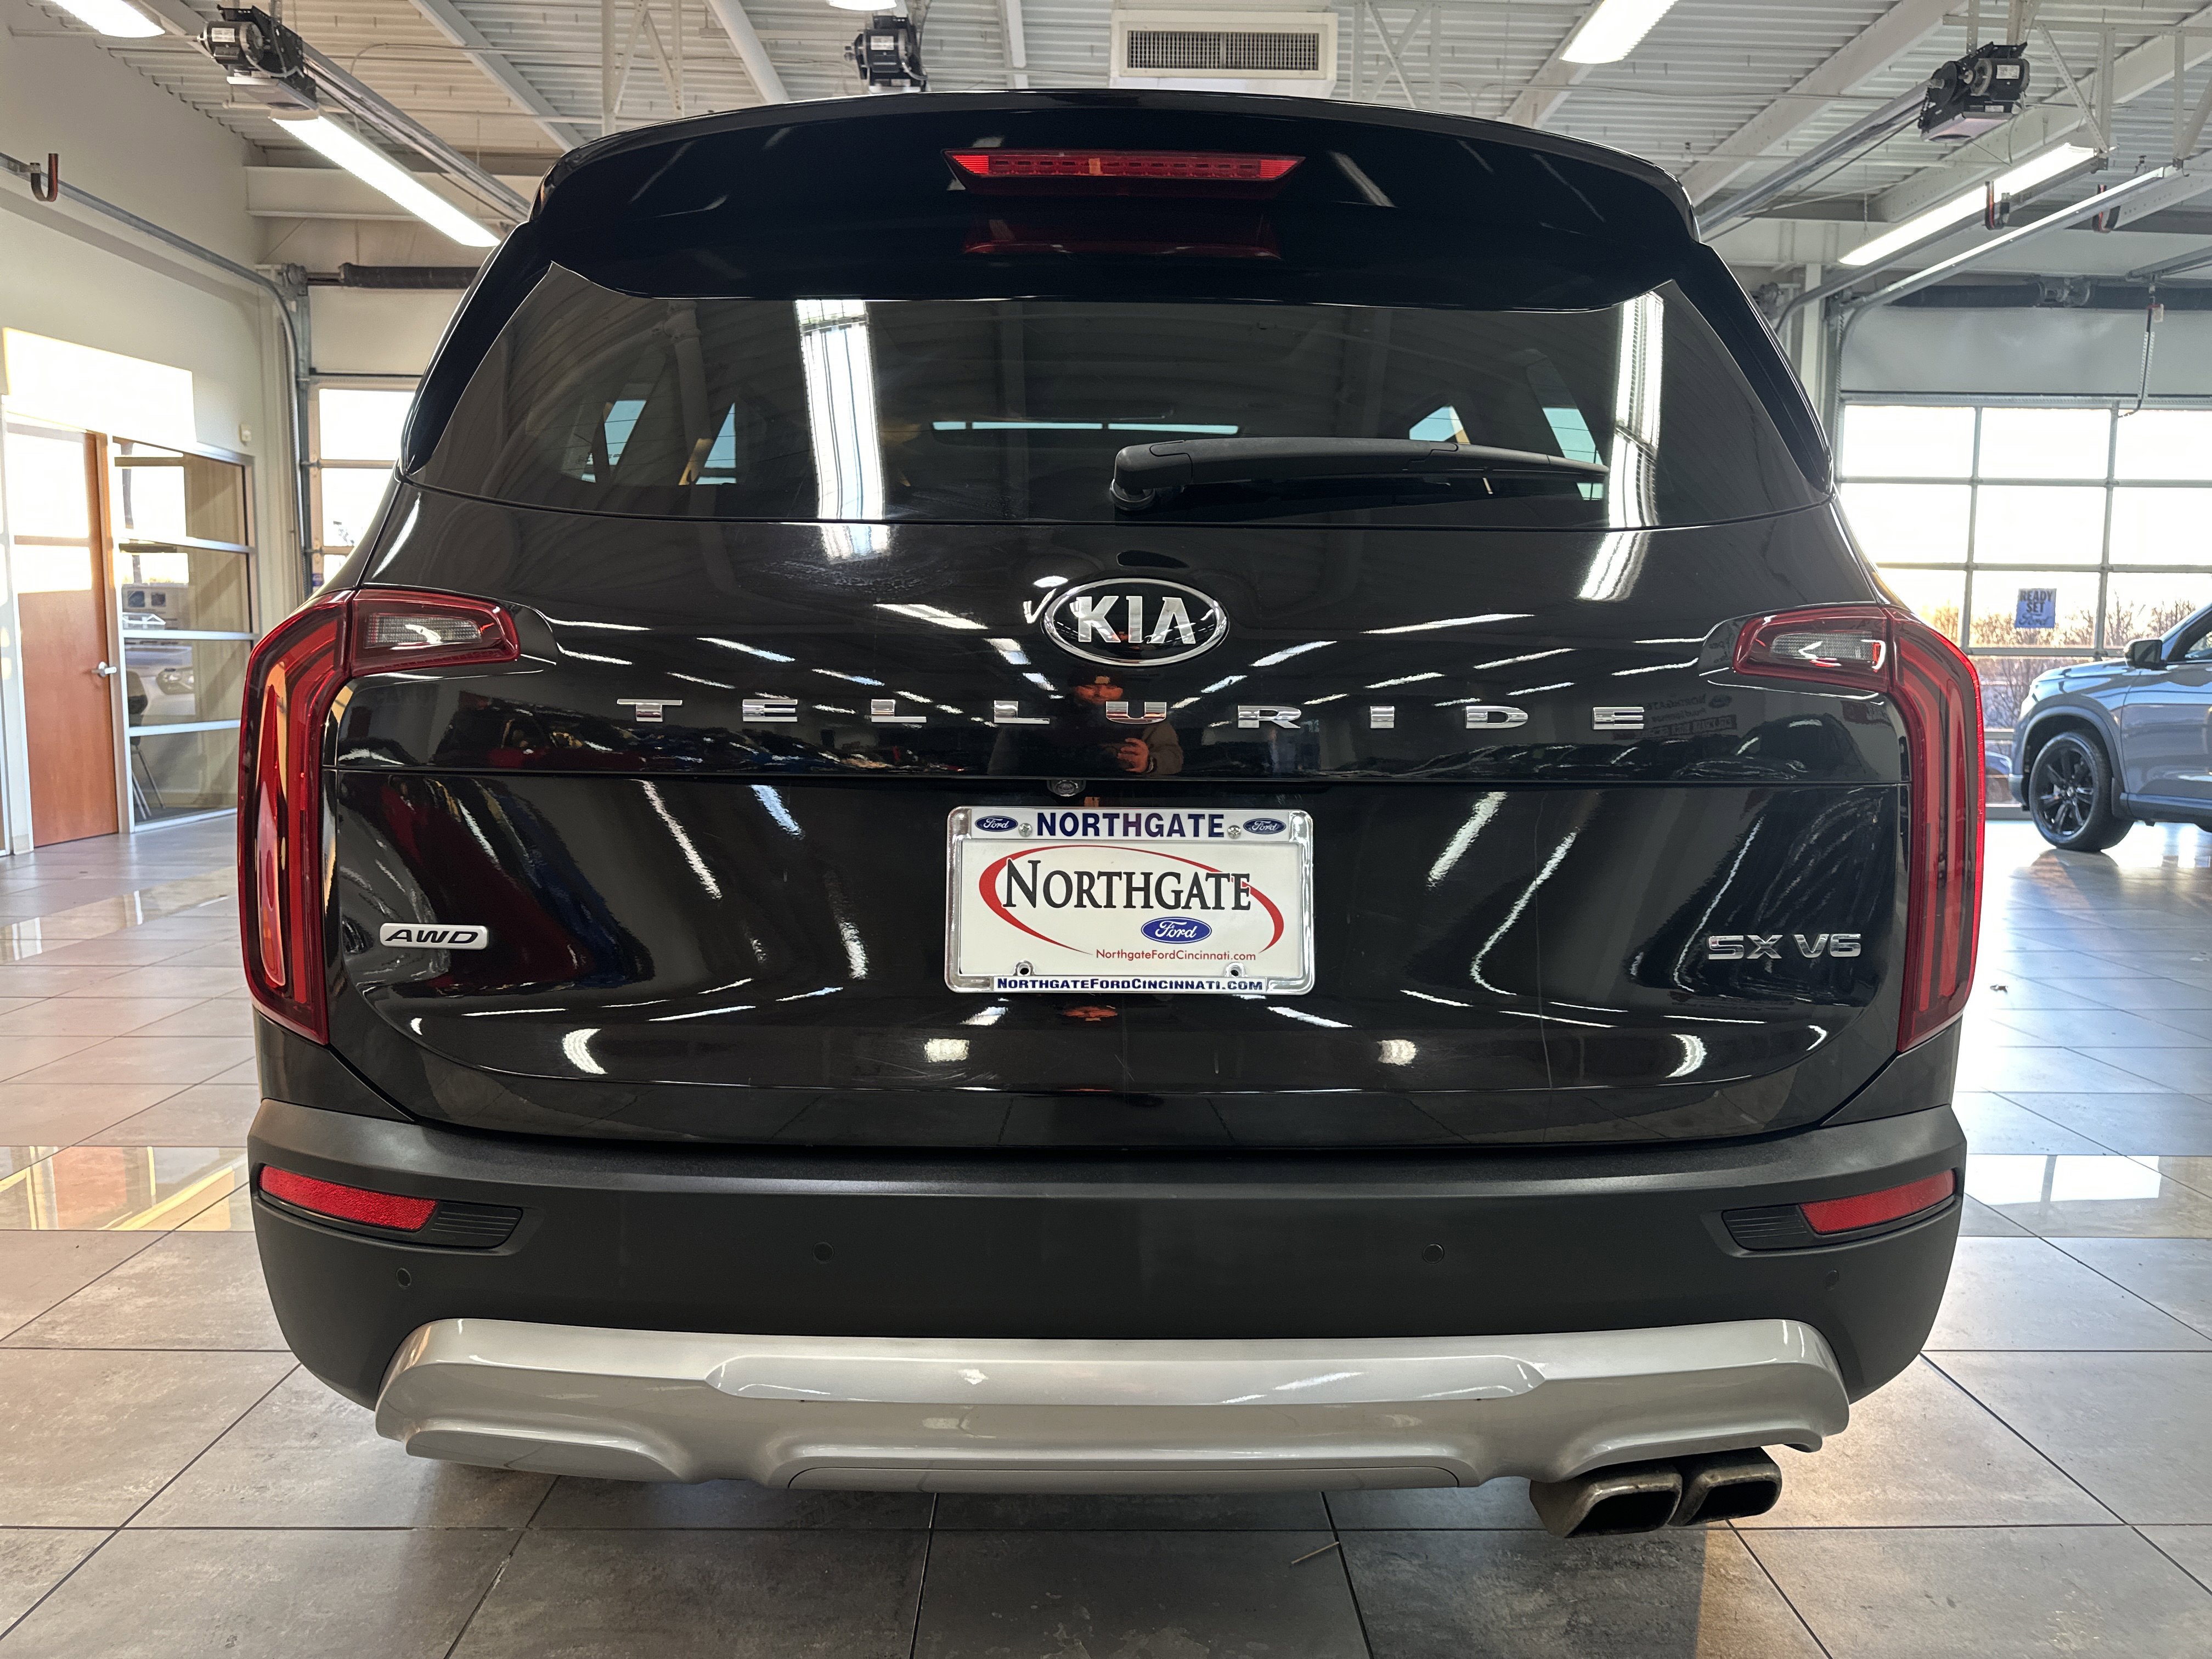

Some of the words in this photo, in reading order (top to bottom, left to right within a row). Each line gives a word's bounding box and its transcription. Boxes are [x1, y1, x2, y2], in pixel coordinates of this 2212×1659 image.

[2019, 589, 2053, 602] READY
[2026, 601, 2045, 613] SET
[1076, 595, 1197, 644] KIA
[616, 698, 1645, 730] TELLURIDE
[1037, 812, 1224, 838] NORTHGATE
[1002, 858, 1251, 911] NORTHGATE
[385, 929, 479, 944] AWD
[1154, 920, 1197, 939] Ford
[1096, 949, 1256, 961] NorthgateFordCincinnati.com
[1708, 934, 1783, 960] SX
[1793, 933, 1861, 958] V6
[996, 977, 1263, 990] NORTHGATEFORDCINCINNATI.COM
